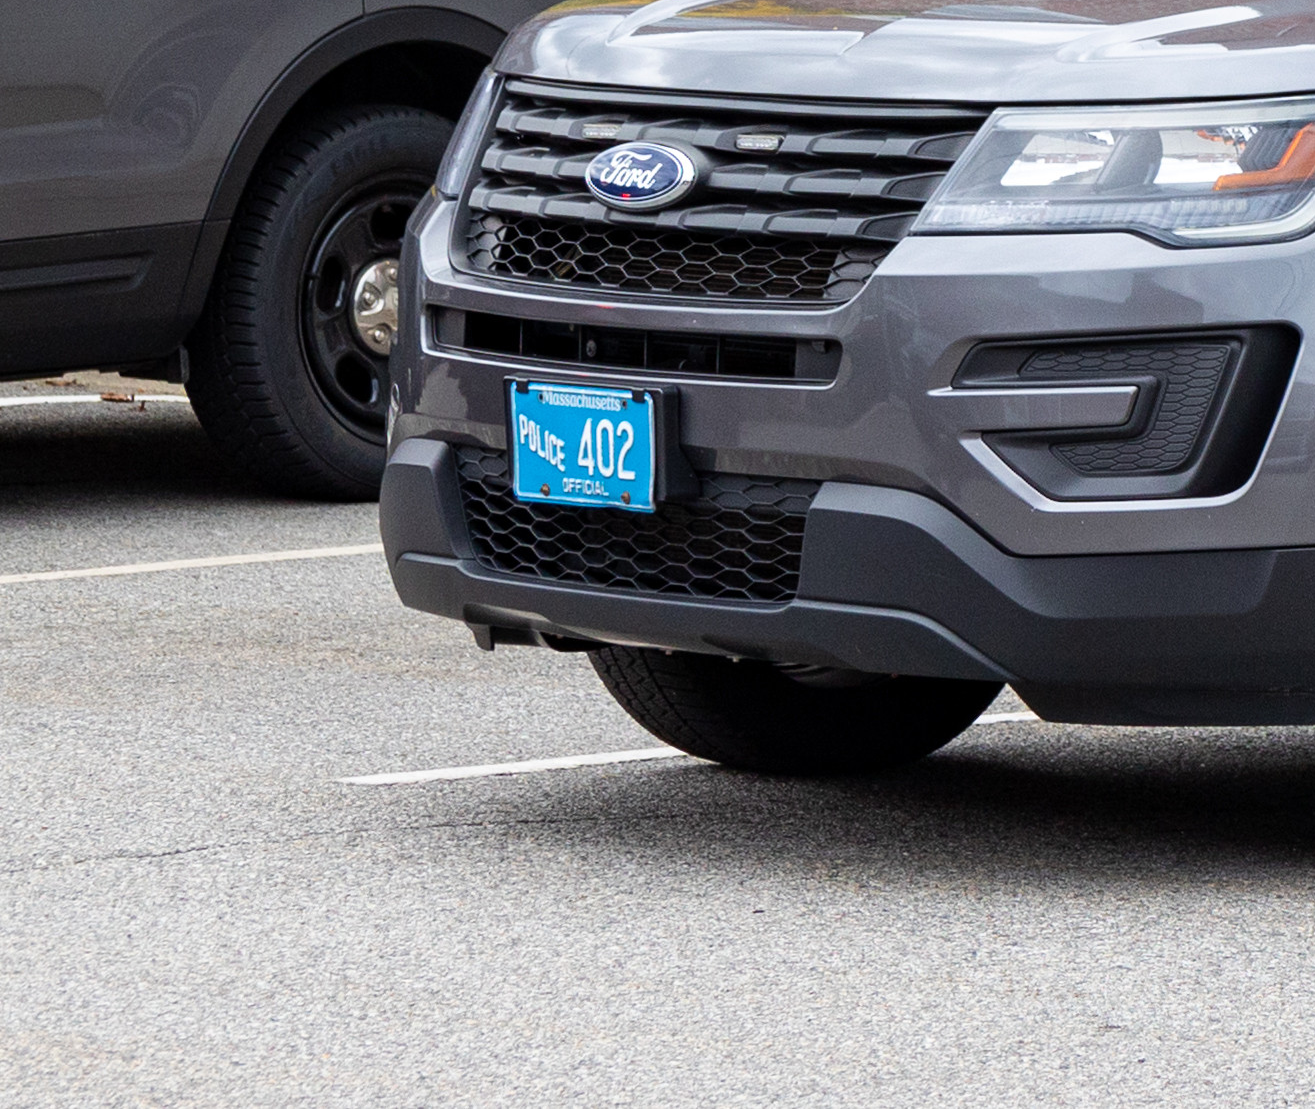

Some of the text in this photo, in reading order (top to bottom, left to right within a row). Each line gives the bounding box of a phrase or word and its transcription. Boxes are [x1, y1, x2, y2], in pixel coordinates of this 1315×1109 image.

[601, 151, 662, 189] Ford
[541, 392, 621, 412] Massachusetts
[518, 413, 636, 480] POLICE 402
[562, 477, 610, 497] OFFICIAL
